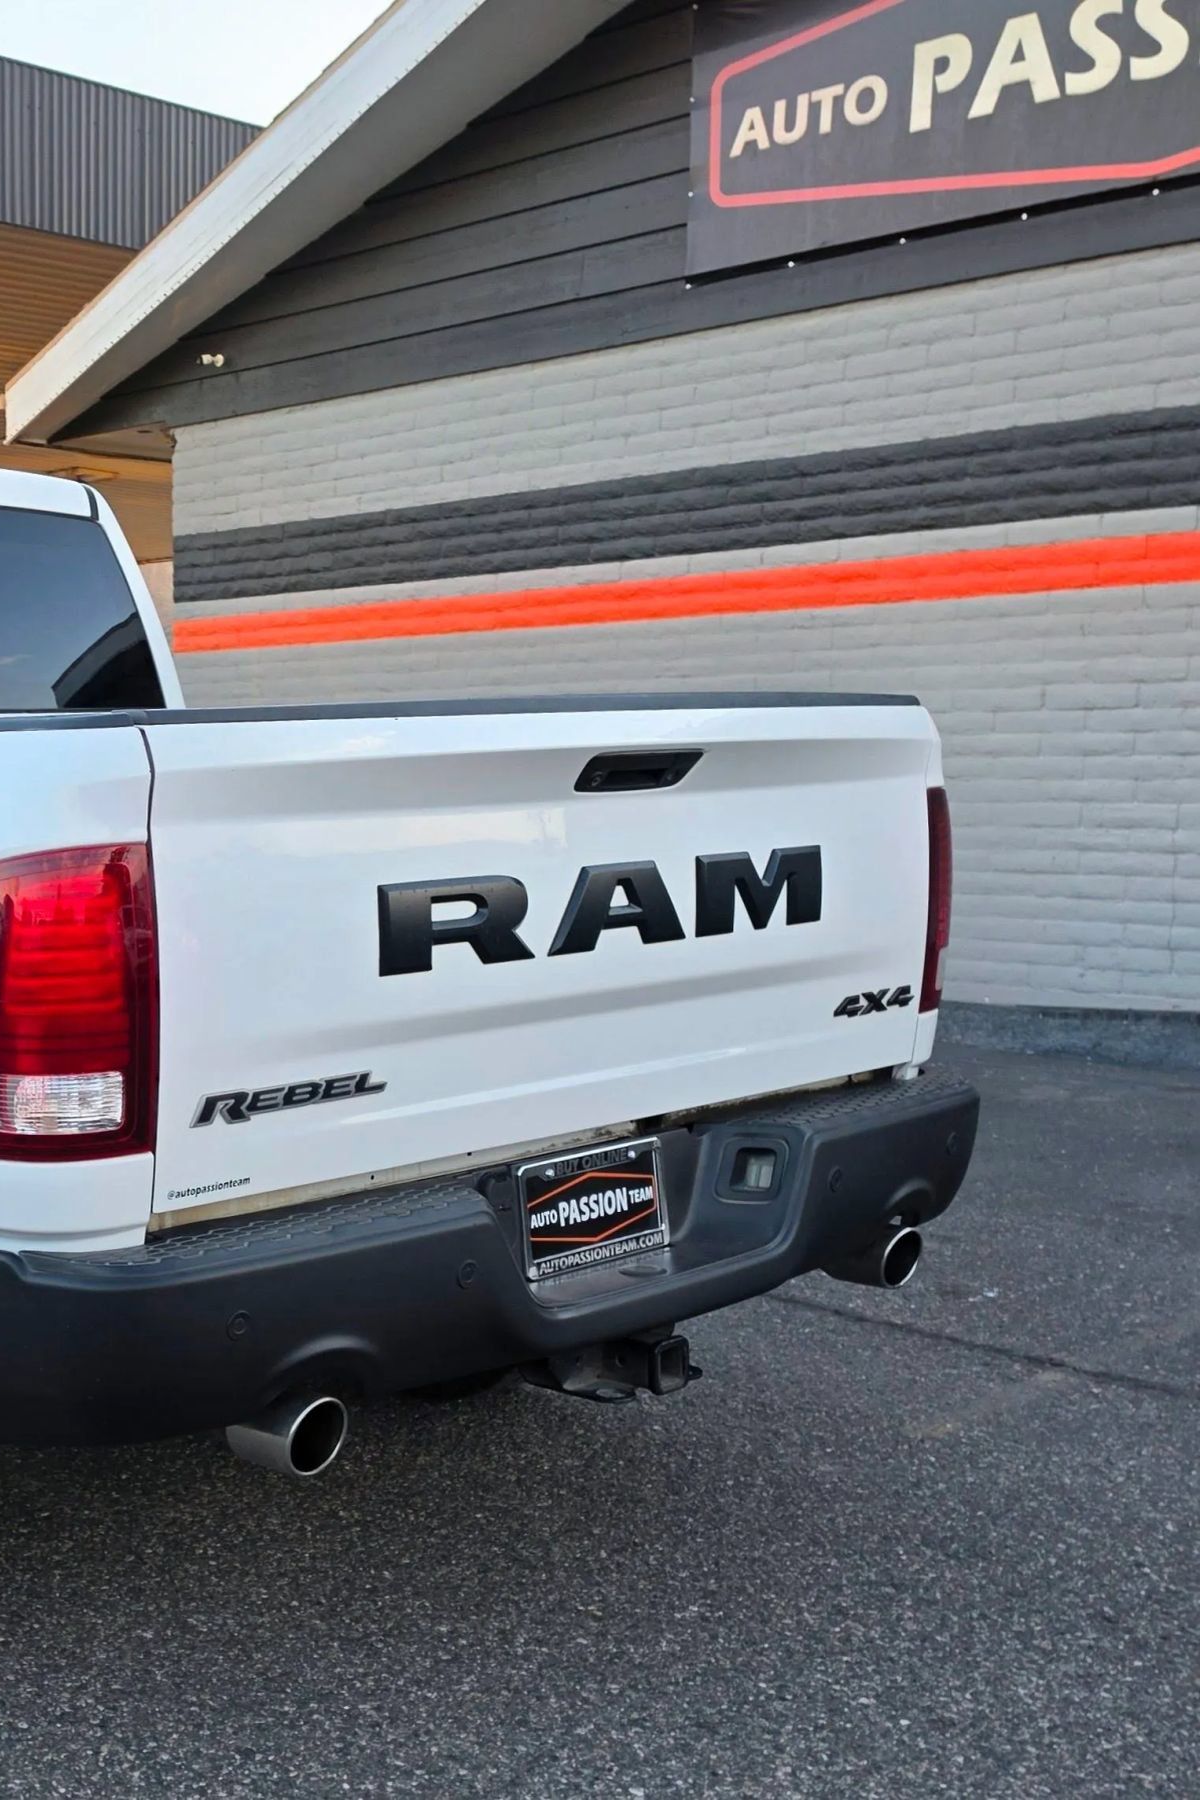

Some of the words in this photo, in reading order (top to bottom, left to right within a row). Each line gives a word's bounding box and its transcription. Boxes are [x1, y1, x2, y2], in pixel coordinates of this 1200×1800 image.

[729, 74, 889, 158] AUTO
[909, 0, 1191, 133] PASS
[377, 844, 822, 978] RAM
[189, 1069, 388, 1129] REBEL
[555, 1161, 579, 1176] BUY
[581, 1149, 628, 1169] ONLINE
[166, 1176, 251, 1201] @autopassionteam
[530, 1208, 558, 1229] AUTO
[558, 1186, 628, 1227] PASSION
[628, 1185, 654, 1205] TEAM
[538, 1232, 665, 1276] AUTOPASSIONTEAM.COM
